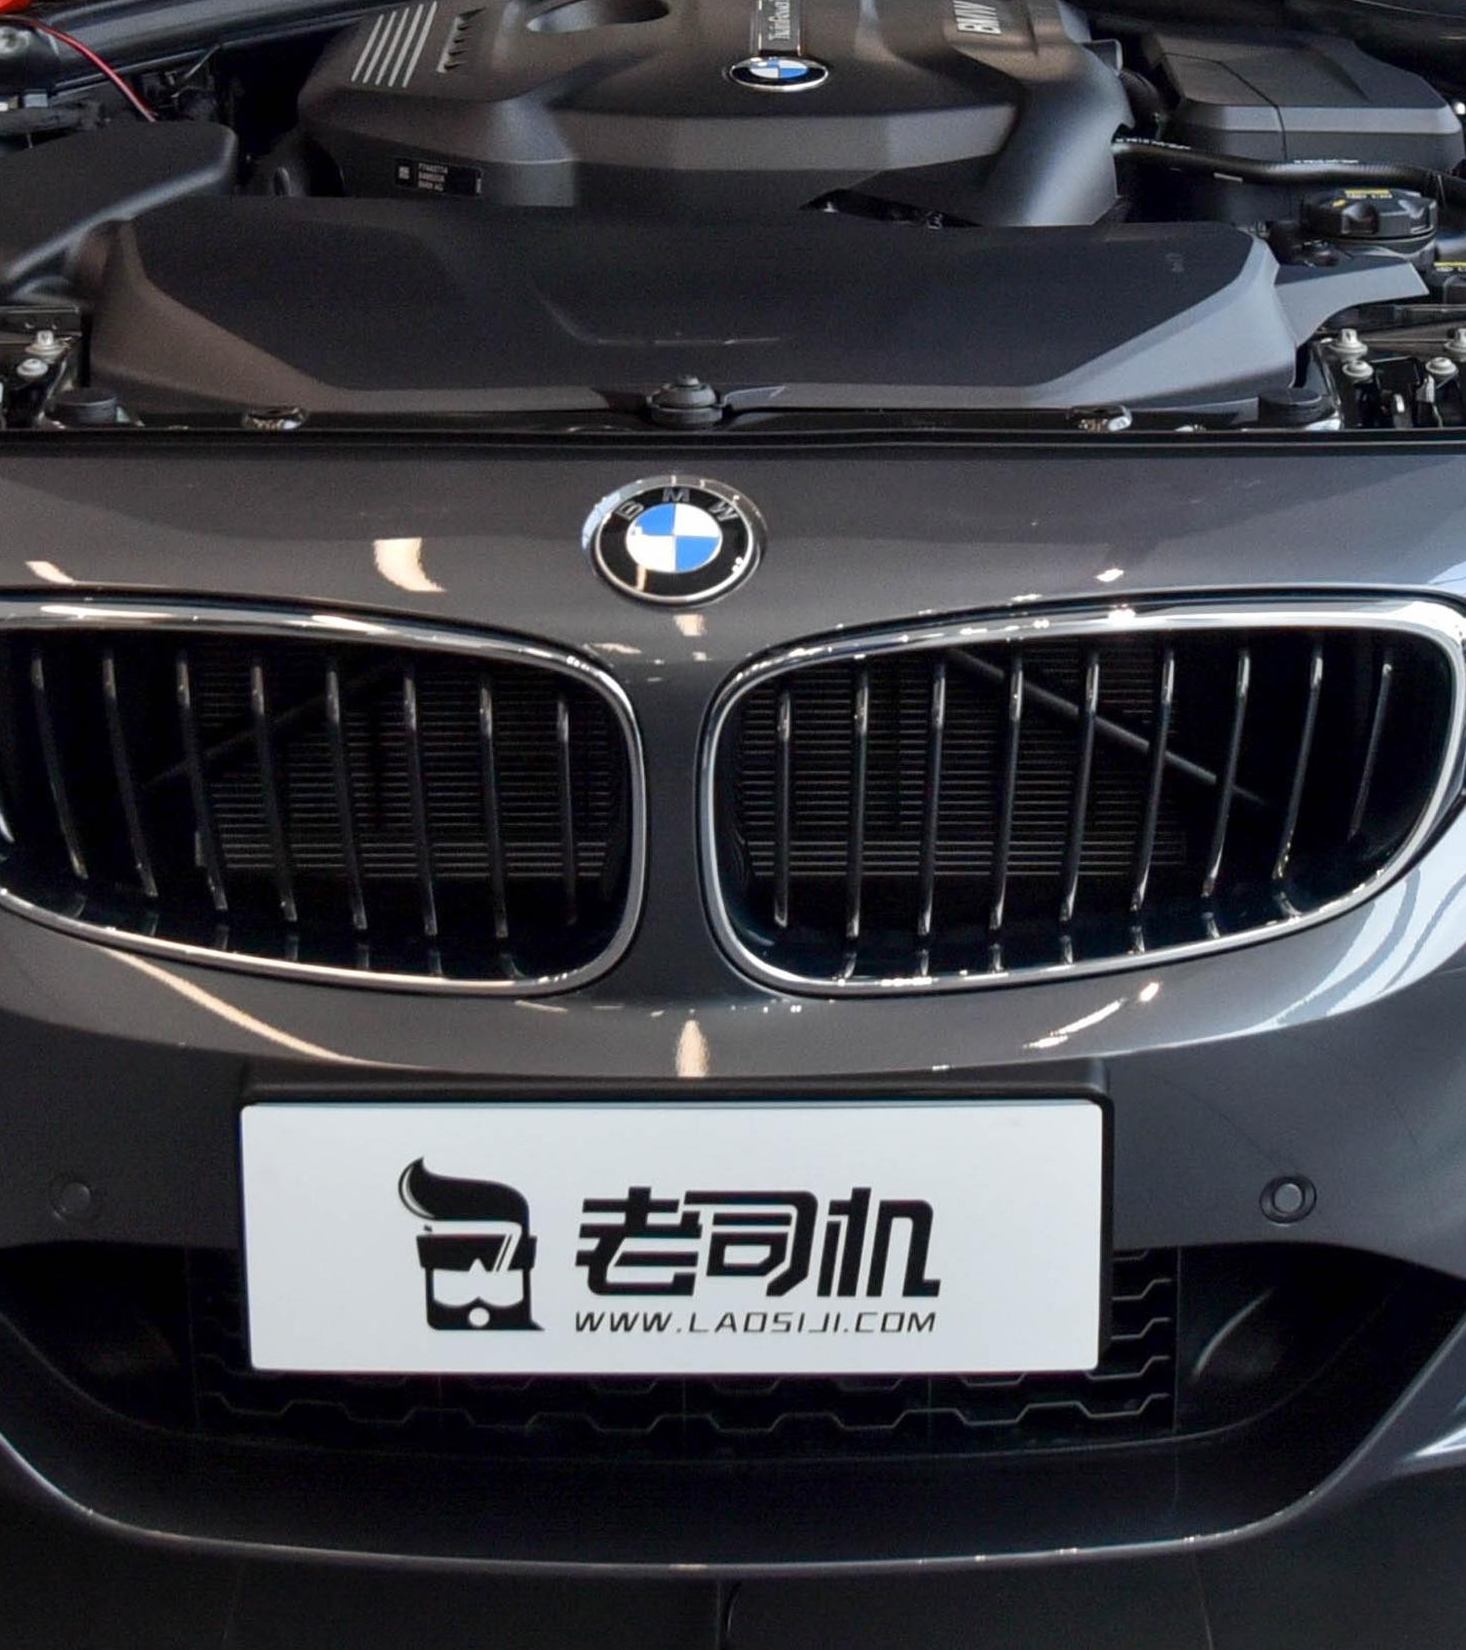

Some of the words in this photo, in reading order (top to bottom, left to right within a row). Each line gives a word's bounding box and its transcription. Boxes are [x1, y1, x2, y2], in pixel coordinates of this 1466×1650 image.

[615, 486, 740, 522] BMW
[574, 1186, 941, 1298] 老司机
[574, 1311, 937, 1335] WWW.LAOSIJI.COM
